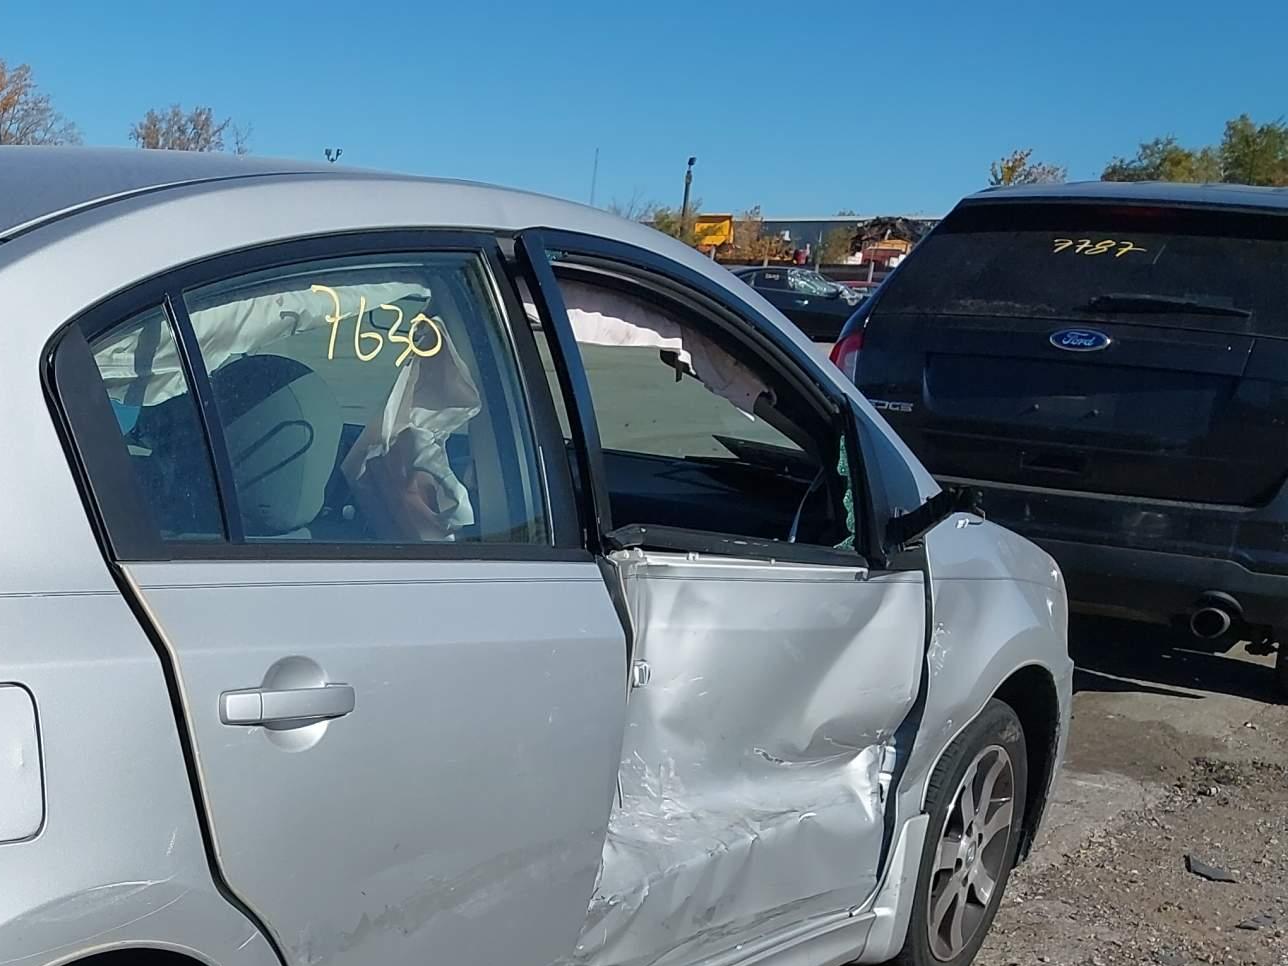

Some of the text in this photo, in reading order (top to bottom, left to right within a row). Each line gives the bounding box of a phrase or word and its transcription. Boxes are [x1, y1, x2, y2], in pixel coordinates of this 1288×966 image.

[1053, 238, 1148, 258] 7787
[310, 284, 443, 368] 7630
[1061, 331, 1094, 347] Ford
